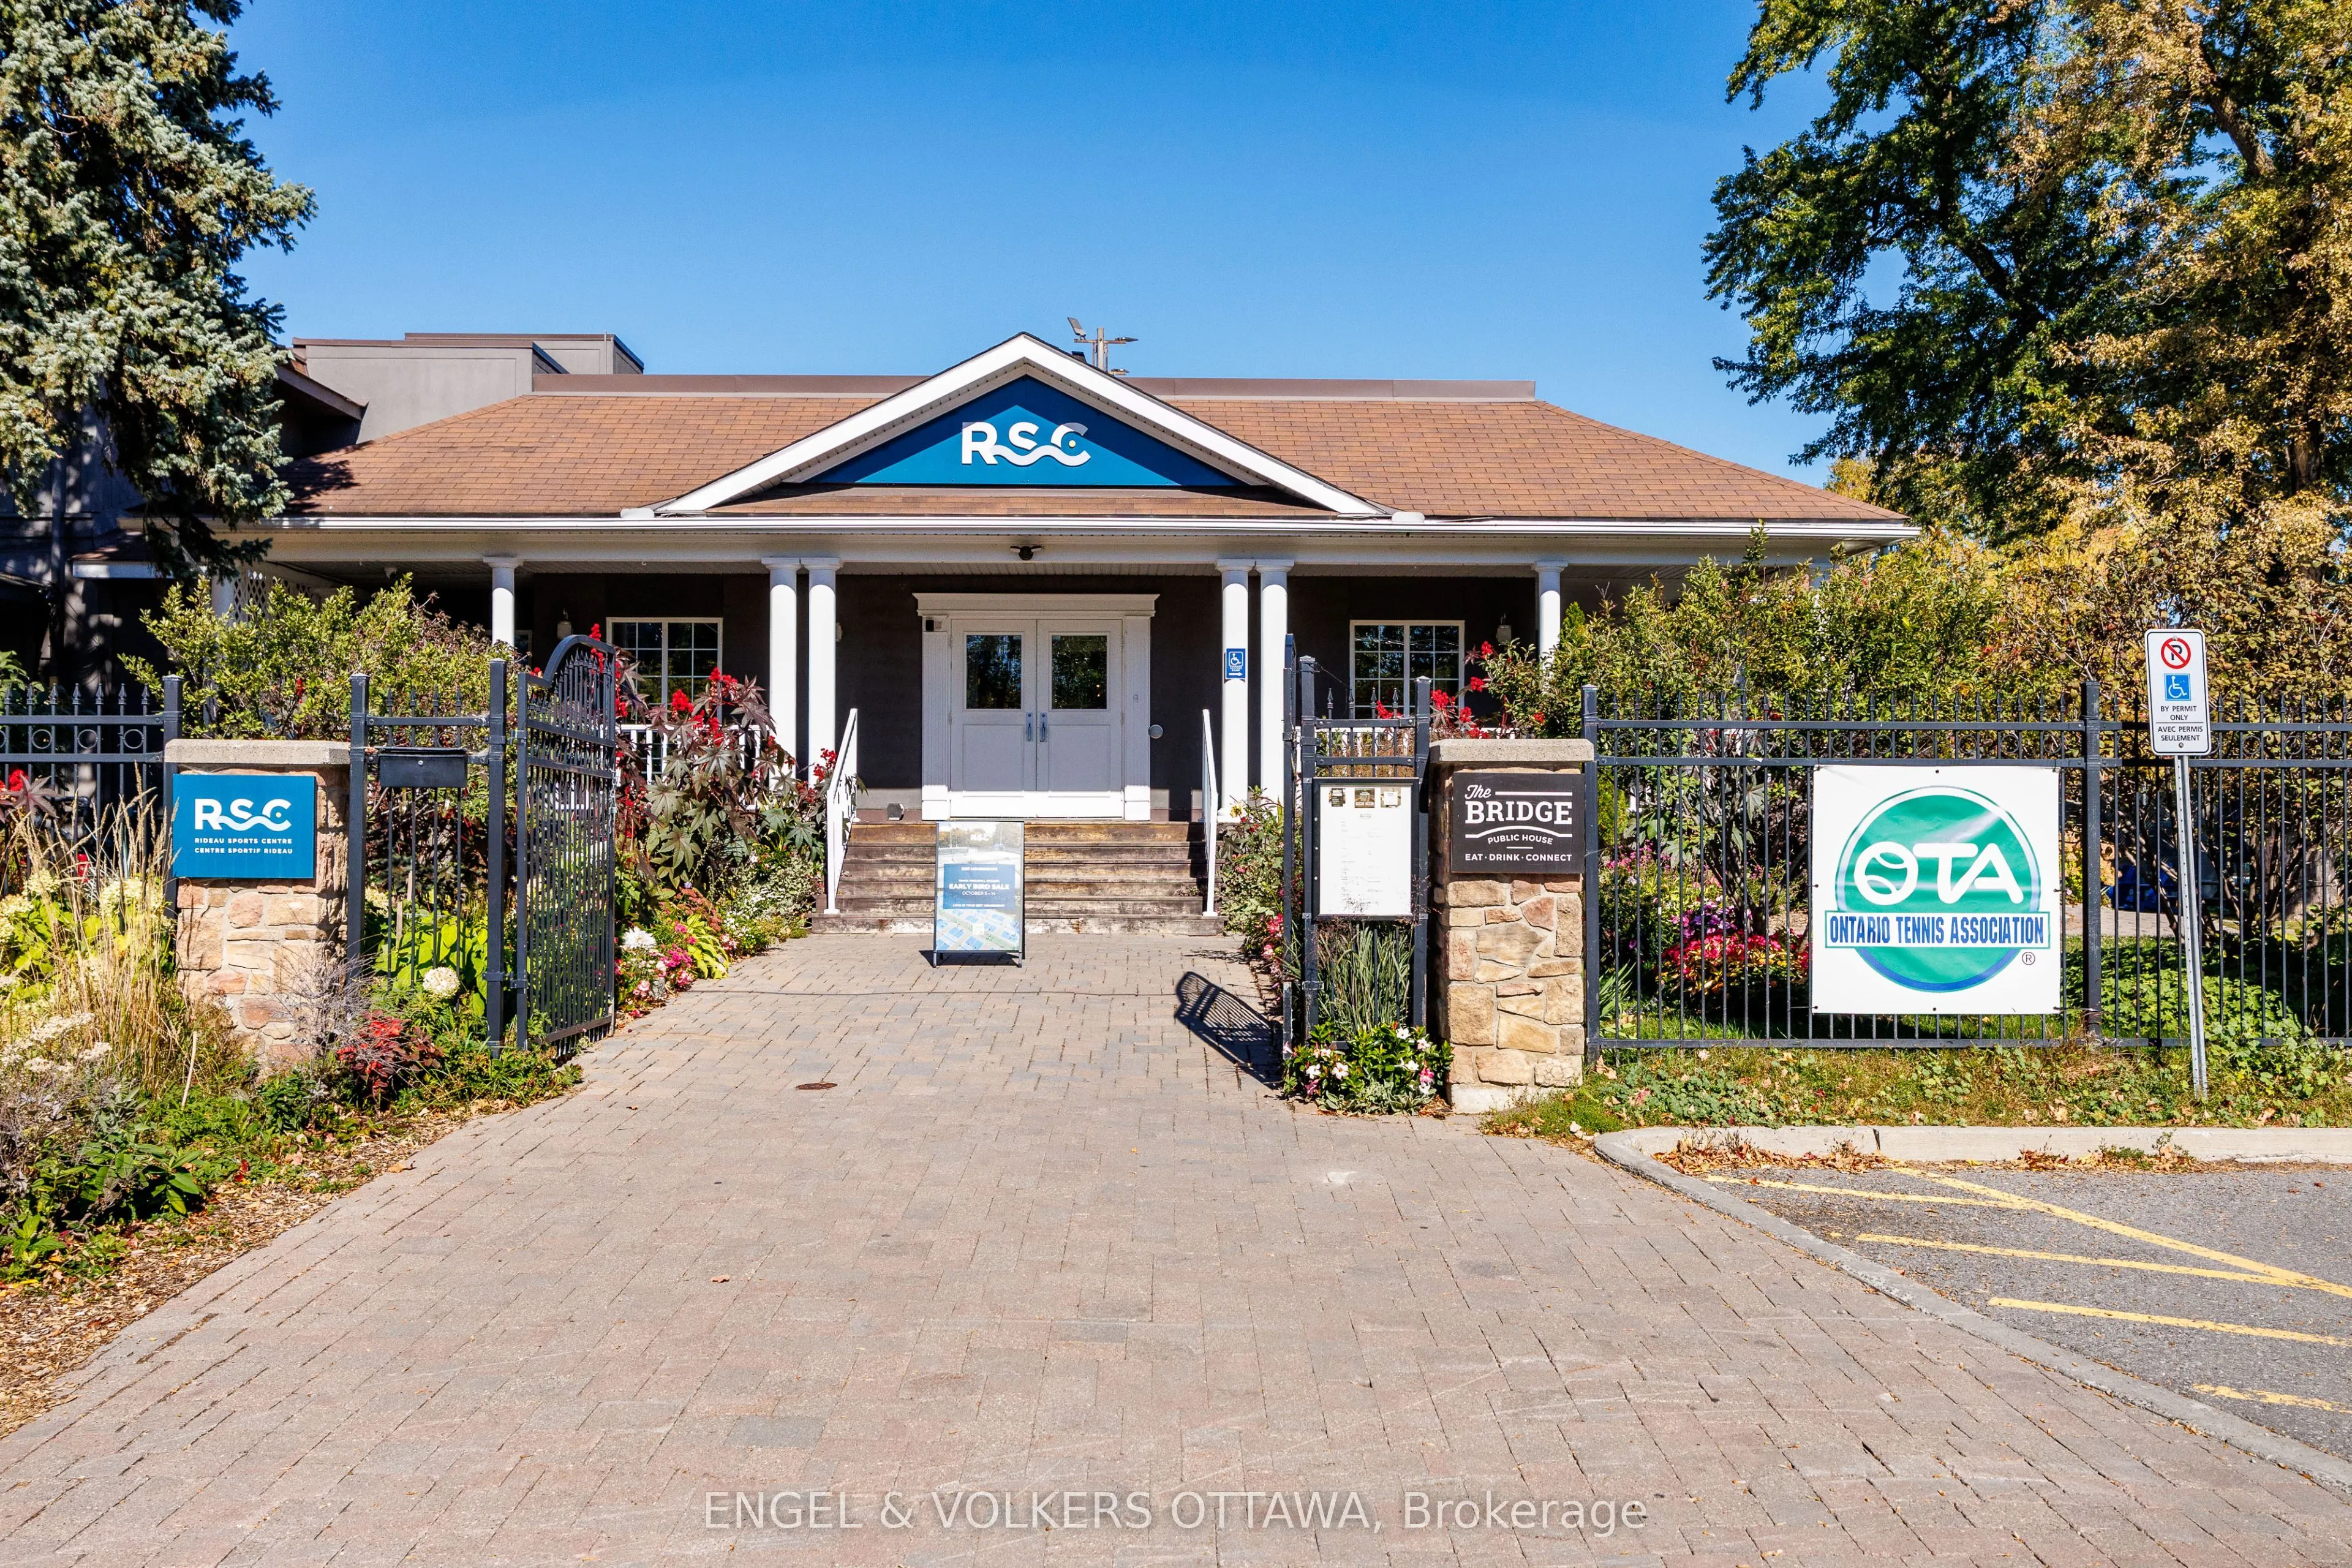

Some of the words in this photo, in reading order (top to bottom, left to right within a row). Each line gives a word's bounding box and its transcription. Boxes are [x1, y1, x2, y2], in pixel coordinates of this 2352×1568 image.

[962, 421, 1091, 467] RSC
[1464, 785, 1492, 799] The
[195, 798, 292, 831] RSC
[1464, 801, 1572, 825] BRIDGE
[1487, 834, 1520, 845] PUBLIC
[1522, 834, 1553, 845] HOUSE
[1853, 842, 2024, 905] OTA
[1830, 915, 1891, 944] ONTARIO
[1896, 916, 1944, 944] TENNIS
[1950, 916, 2044, 944] ASSOCIATION
